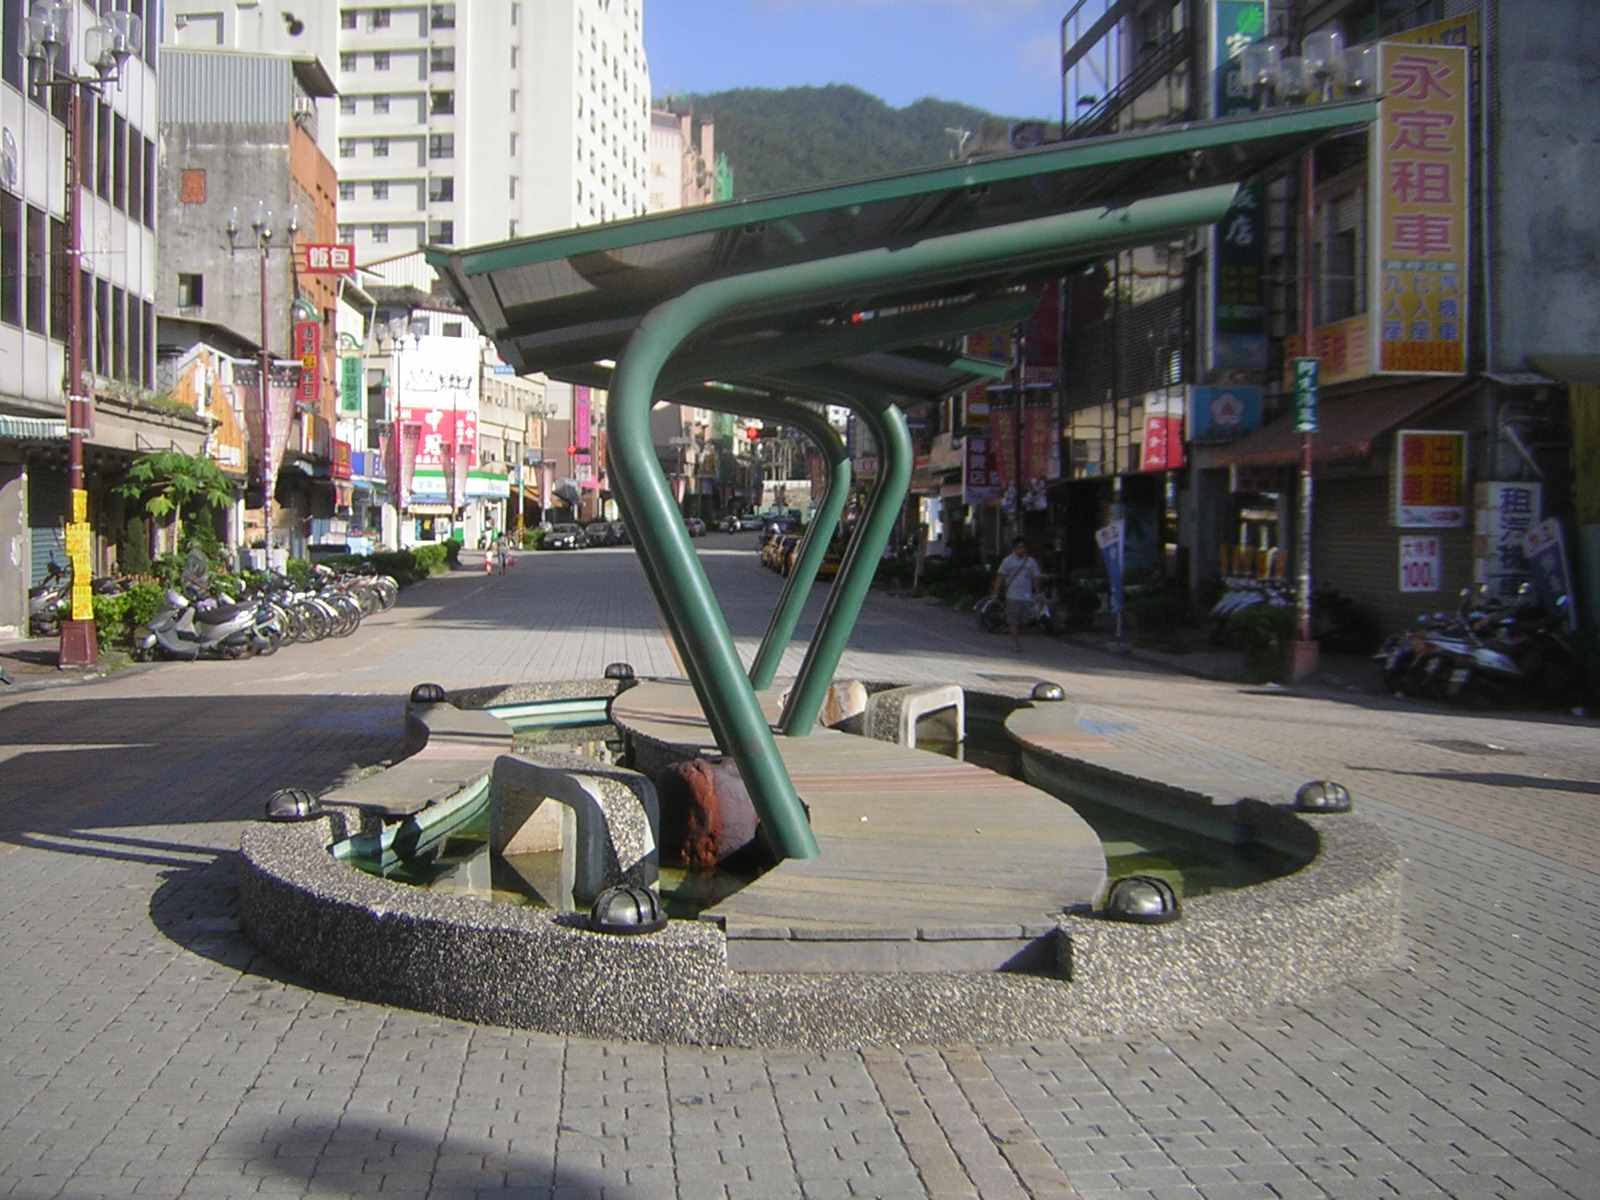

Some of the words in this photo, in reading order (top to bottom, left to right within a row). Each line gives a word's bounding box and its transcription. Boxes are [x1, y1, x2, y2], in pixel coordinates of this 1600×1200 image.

[1389, 55, 1453, 256] 永定租車
[310, 247, 350, 268] 飯包
[1403, 561, 1431, 588] 100
